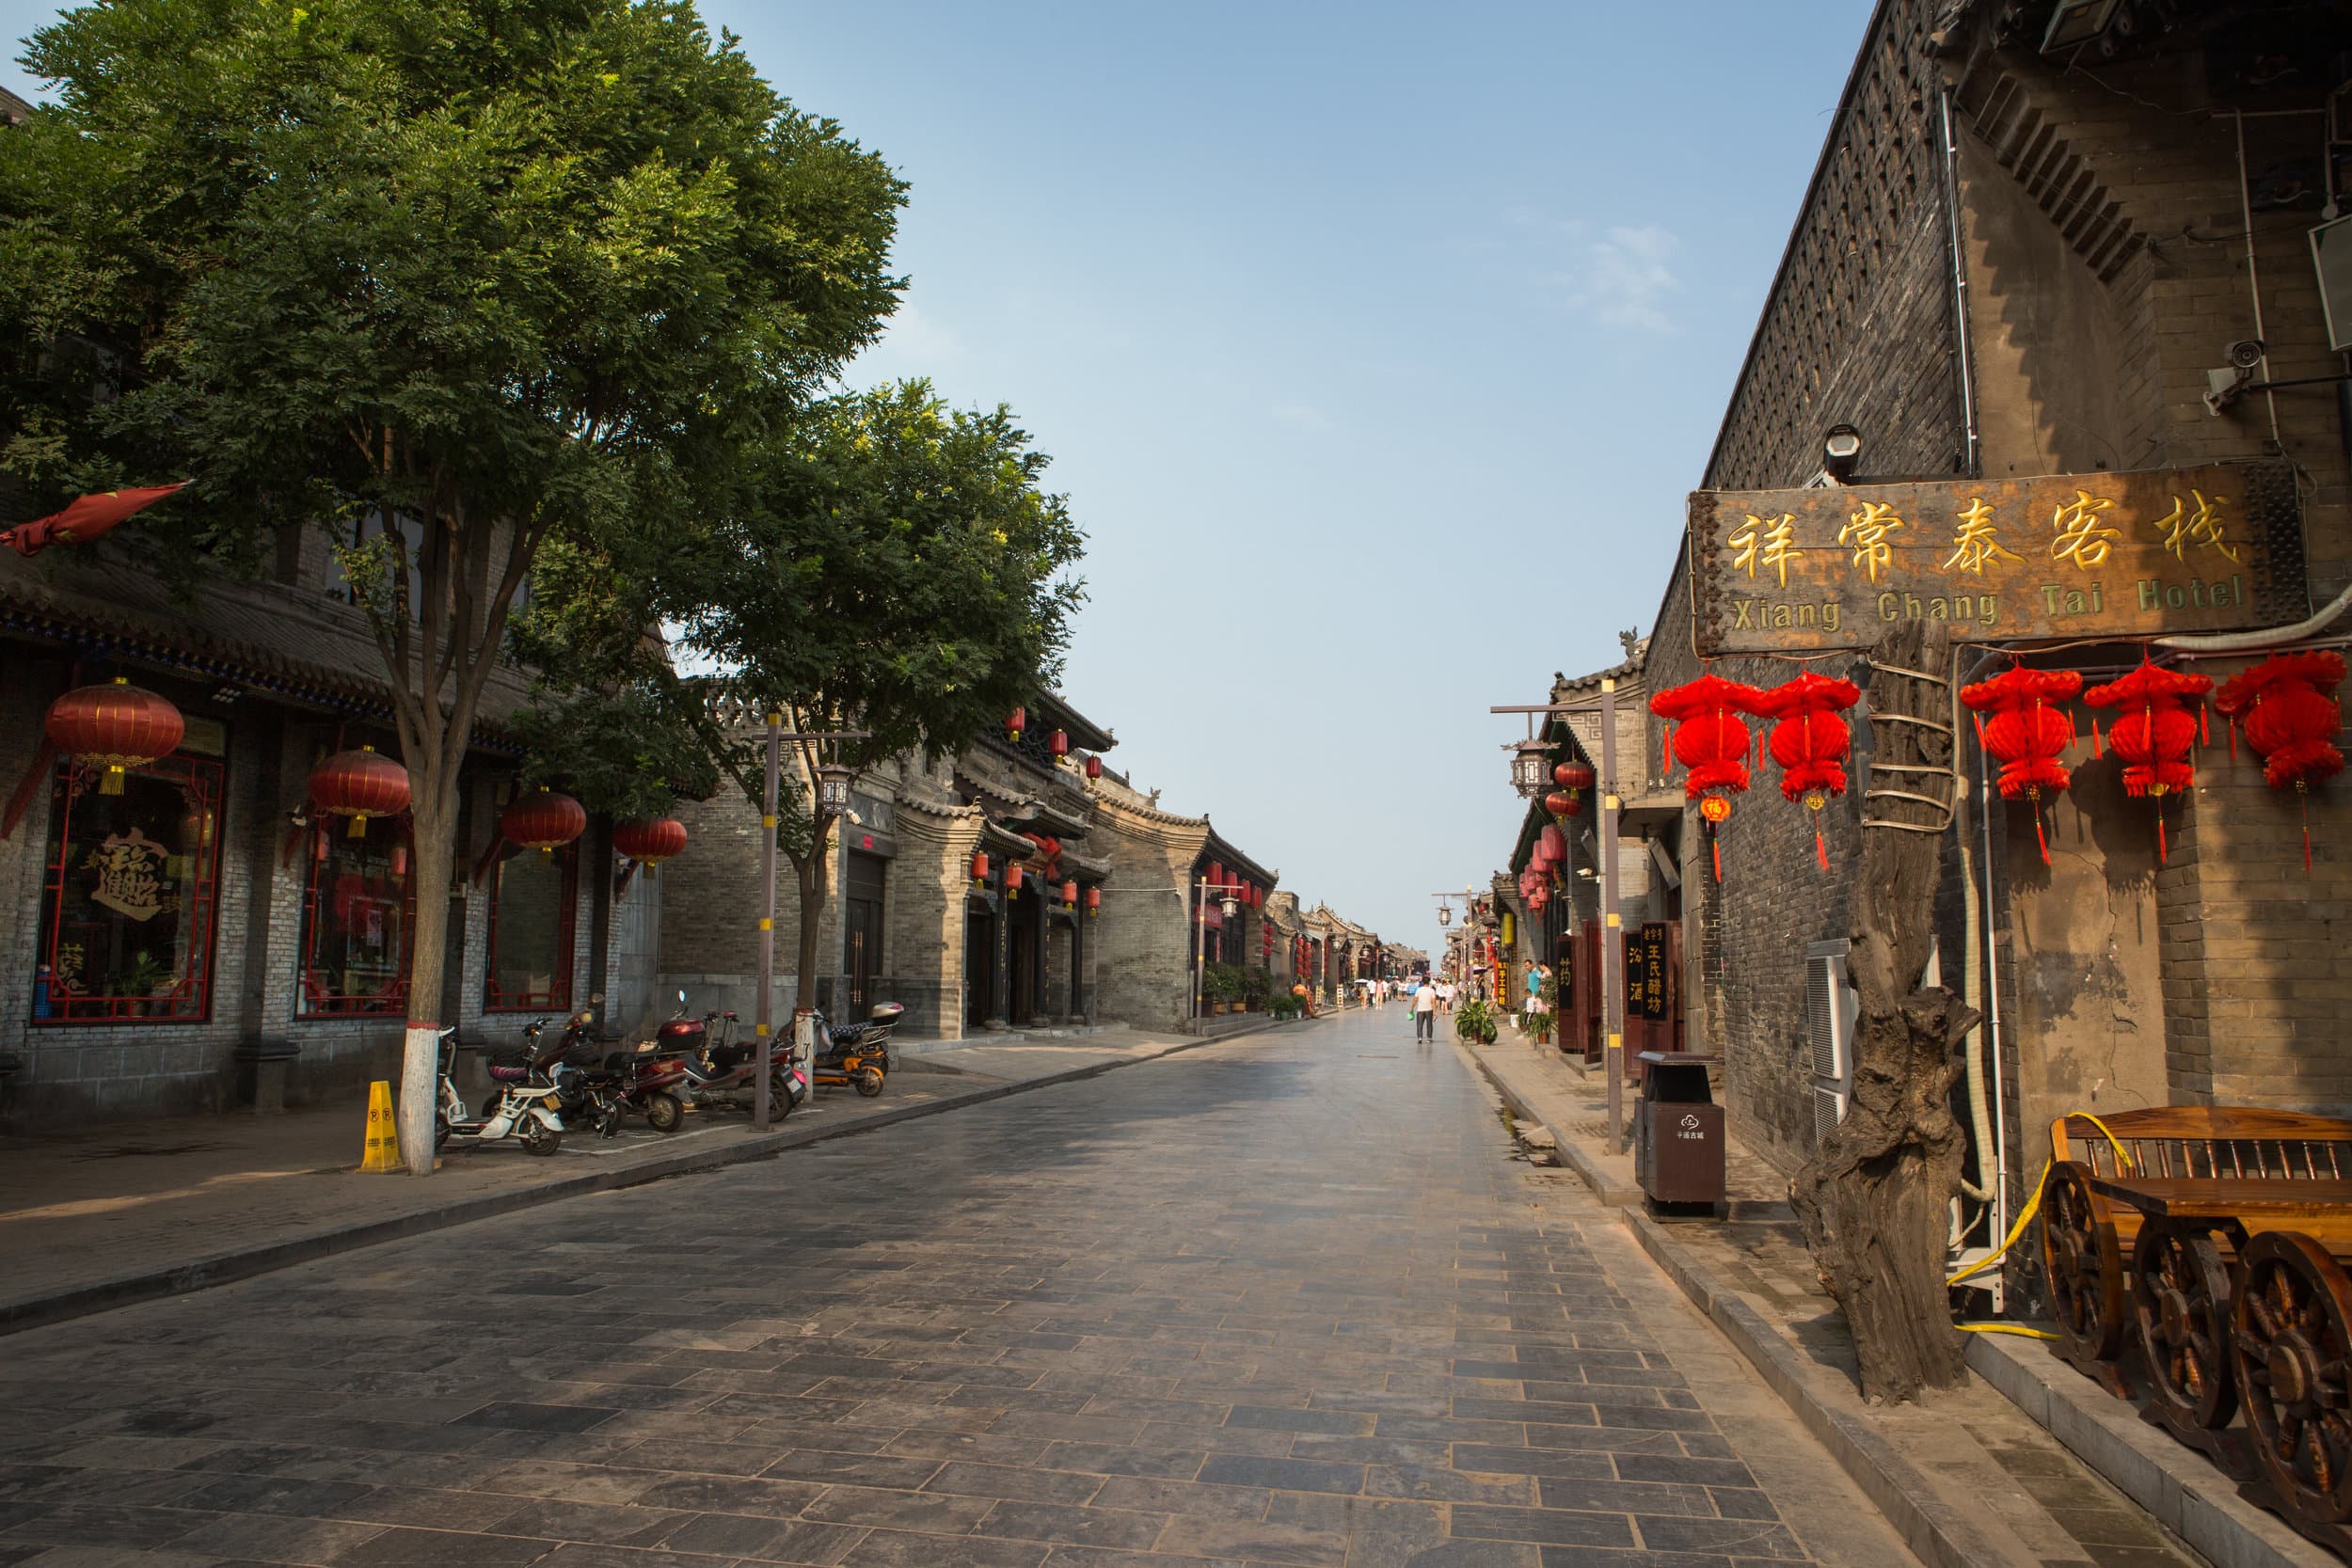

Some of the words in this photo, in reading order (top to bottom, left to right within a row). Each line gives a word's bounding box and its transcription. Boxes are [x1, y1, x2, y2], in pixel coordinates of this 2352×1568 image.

[1727, 488, 2240, 588] 祥常泰客栈
[1732, 598, 1841, 633] Xiang
[1877, 591, 1998, 626] Chang
[2041, 581, 2103, 617] Tai
[2137, 573, 2244, 611] Hotel
[1647, 944, 1661, 1013] 王氏醋坊
